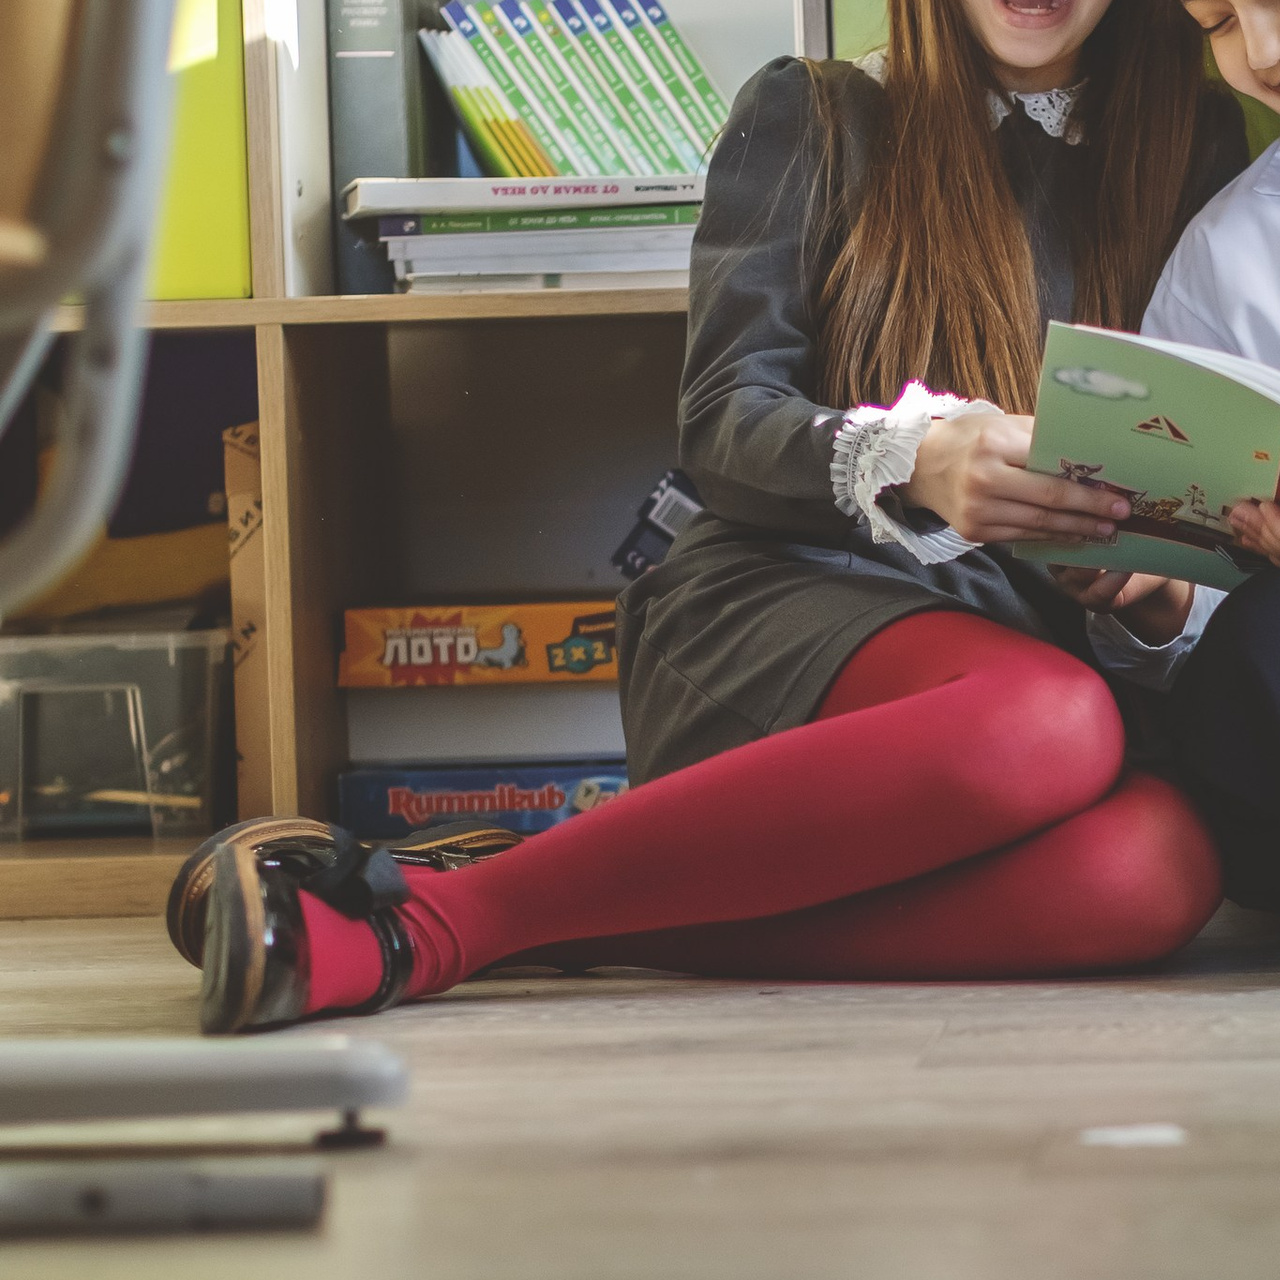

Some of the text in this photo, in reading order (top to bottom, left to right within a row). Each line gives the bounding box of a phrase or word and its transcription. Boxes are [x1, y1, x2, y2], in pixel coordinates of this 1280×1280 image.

[491, 186, 526, 196] НЕБА
[530, 186, 550, 195] ДО
[553, 185, 599, 195] ЗЕМЛИ
[602, 184, 620, 194] ОТ
[382, 636, 479, 667] ЛОТО
[388, 782, 566, 825] Rummikub
